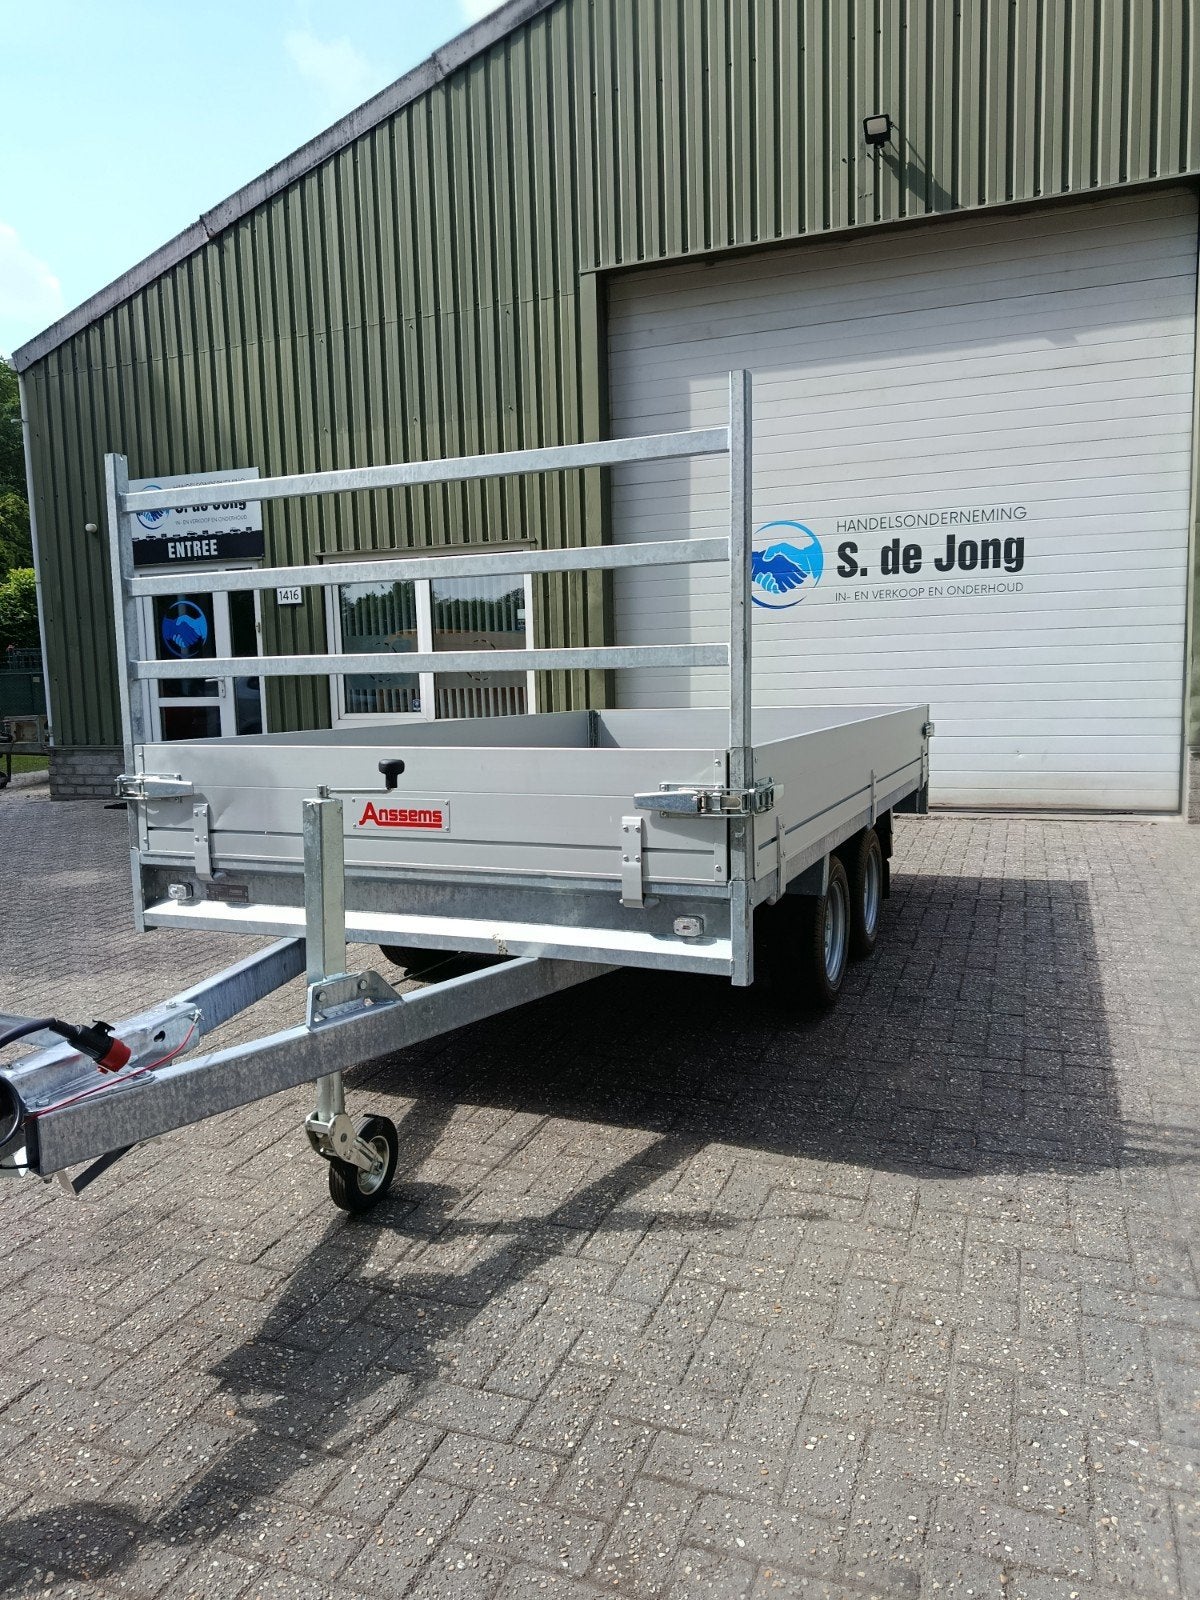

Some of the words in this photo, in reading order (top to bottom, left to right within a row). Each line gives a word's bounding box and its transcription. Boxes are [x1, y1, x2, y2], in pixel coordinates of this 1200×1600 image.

[836, 506, 1028, 533] HANDELSONDERNEMING
[168, 538, 218, 559] ENTREE
[836, 541, 868, 579] S.
[880, 537, 923, 576] de
[934, 533, 1025, 573] Jong
[279, 589, 300, 601] 1416
[835, 591, 851, 602] IN-
[854, 590, 869, 601] EN
[872, 587, 925, 600] VERKOOP
[929, 585, 943, 597] EN
[946, 582, 1024, 596] ONDERHOUD
[359, 801, 443, 827] Anssems
